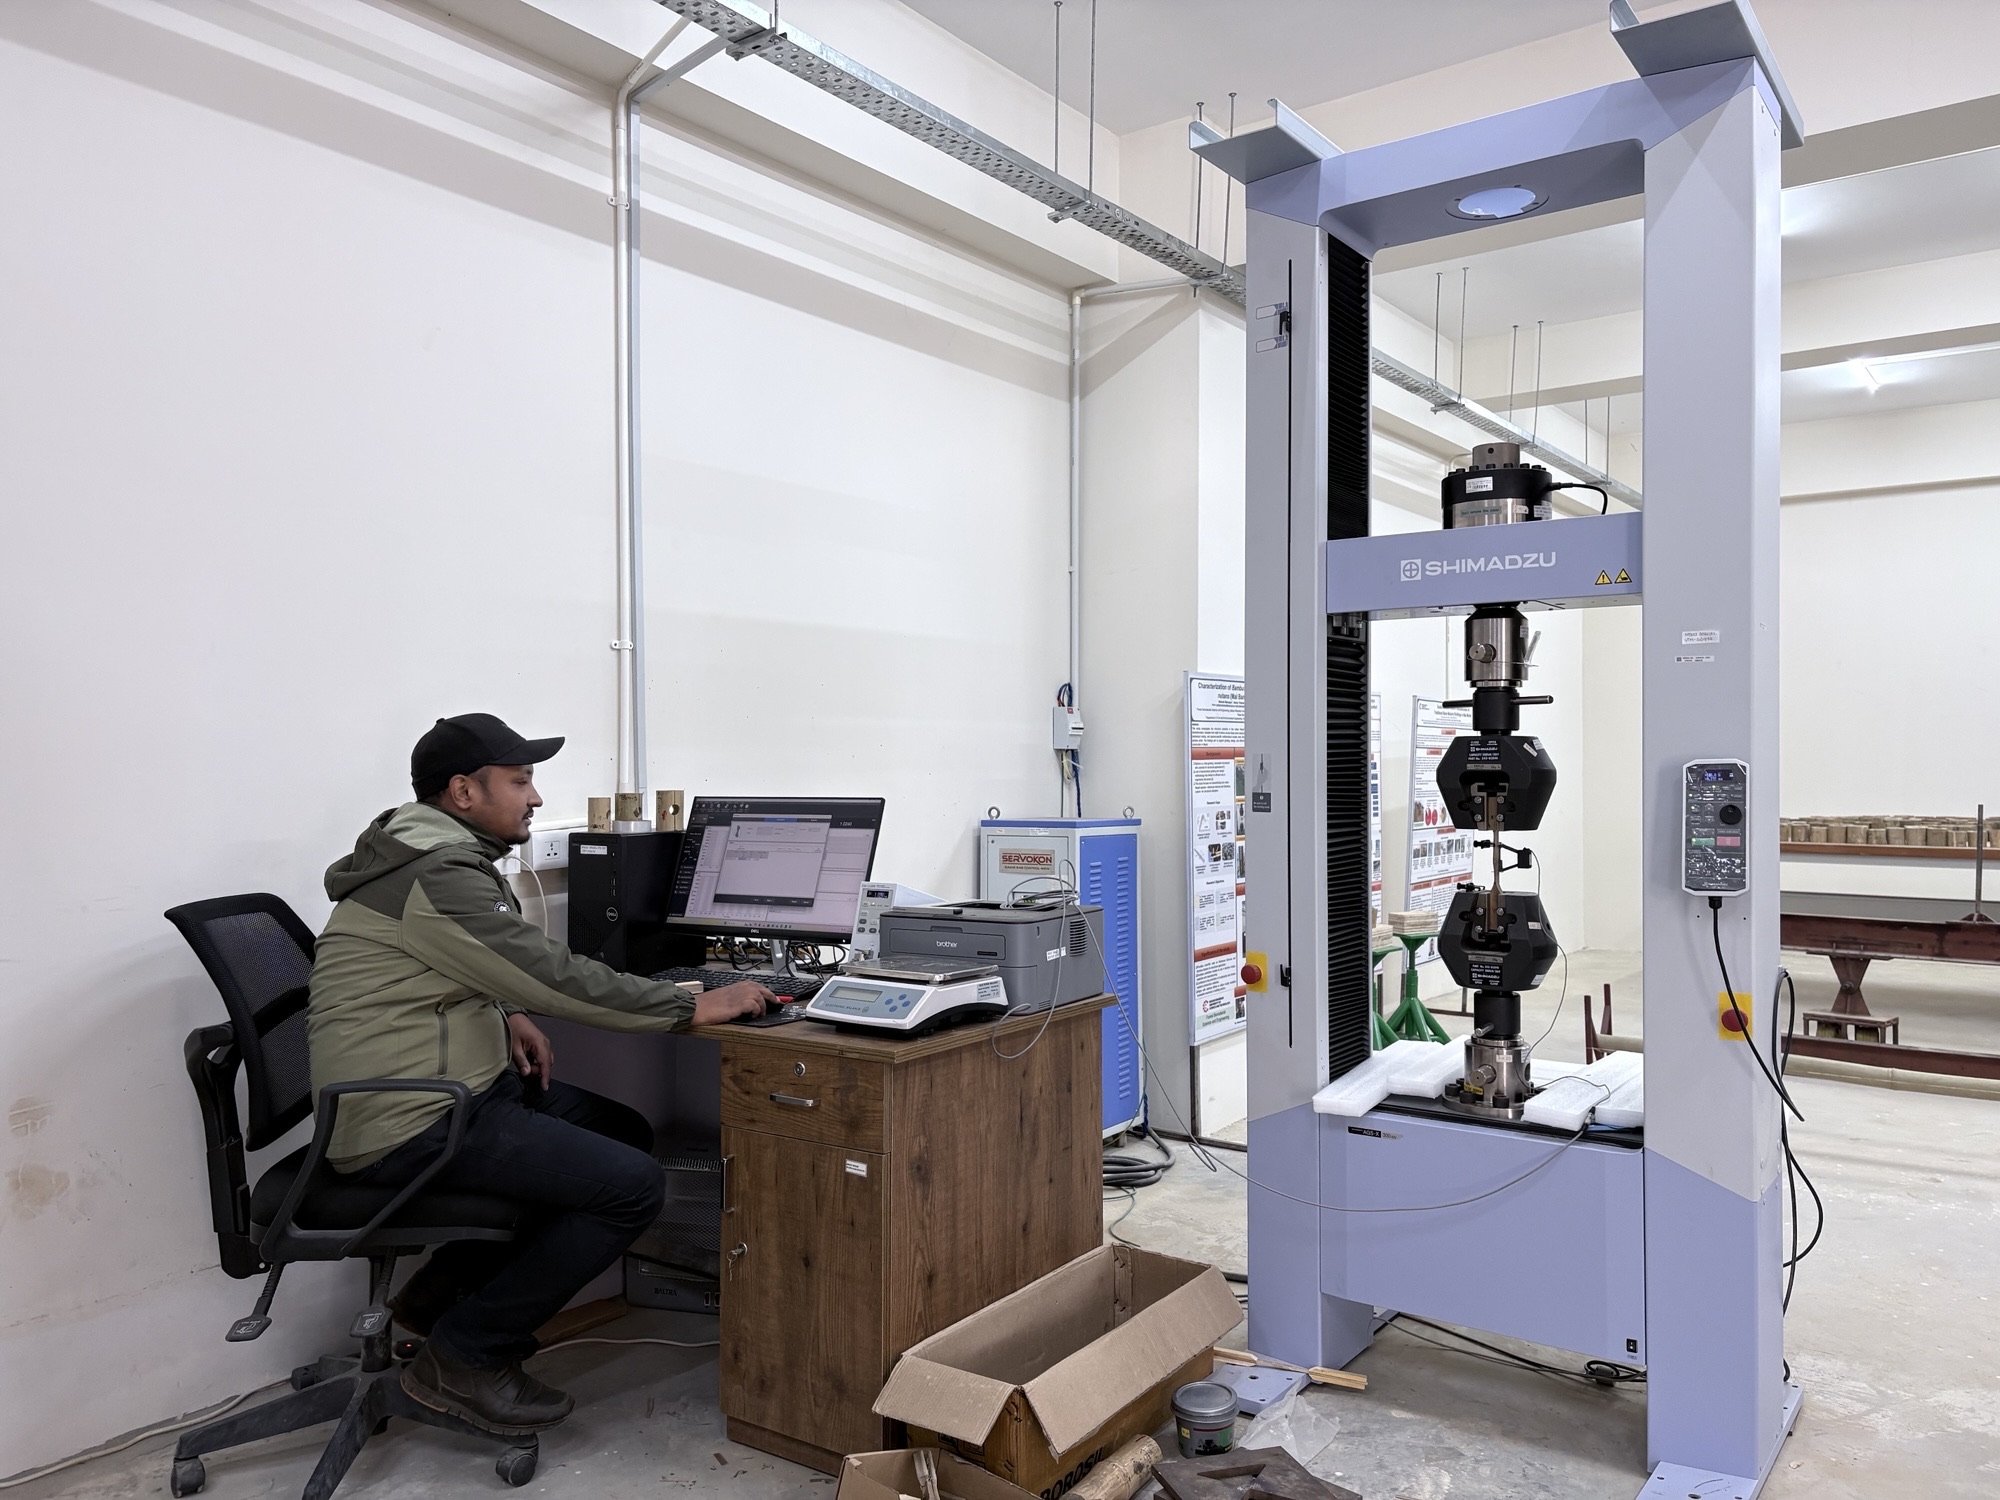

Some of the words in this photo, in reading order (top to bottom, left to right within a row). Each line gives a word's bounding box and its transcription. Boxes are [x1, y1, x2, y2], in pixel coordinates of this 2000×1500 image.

[1425, 552, 1556, 576] SHIMADZU
[1002, 854, 1052, 864] SERVOKON
[654, 1288, 677, 1296] BALTRA
